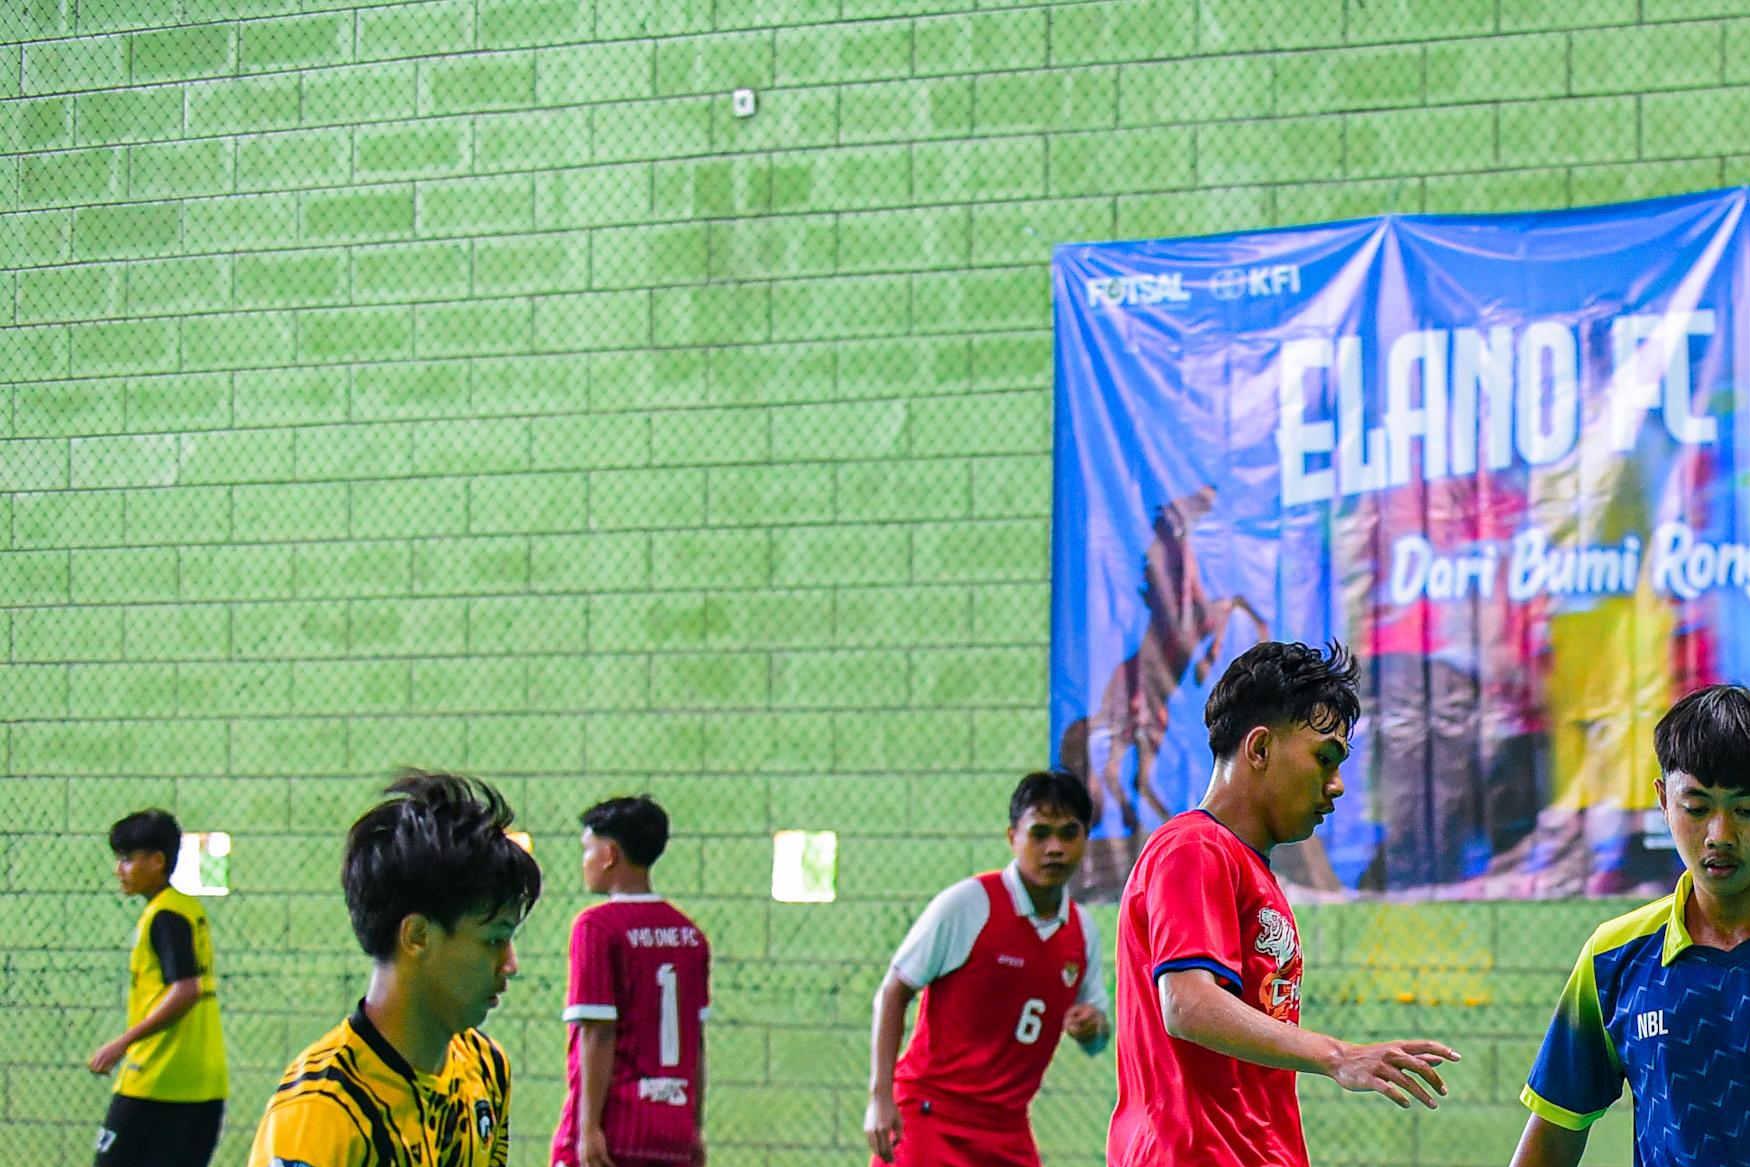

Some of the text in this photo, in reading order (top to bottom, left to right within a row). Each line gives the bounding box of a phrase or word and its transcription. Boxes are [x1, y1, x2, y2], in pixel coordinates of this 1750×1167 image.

[1250, 265, 1301, 295] KFI
[1278, 322, 1578, 508] ELANO
[1611, 309, 1718, 453] FC
[1391, 533, 1496, 604] Dari
[1507, 527, 1640, 601] Bumi
[656, 963, 680, 1067] 1
[1016, 999, 1045, 1044] 6
[1637, 1009, 1668, 1039] NBL
